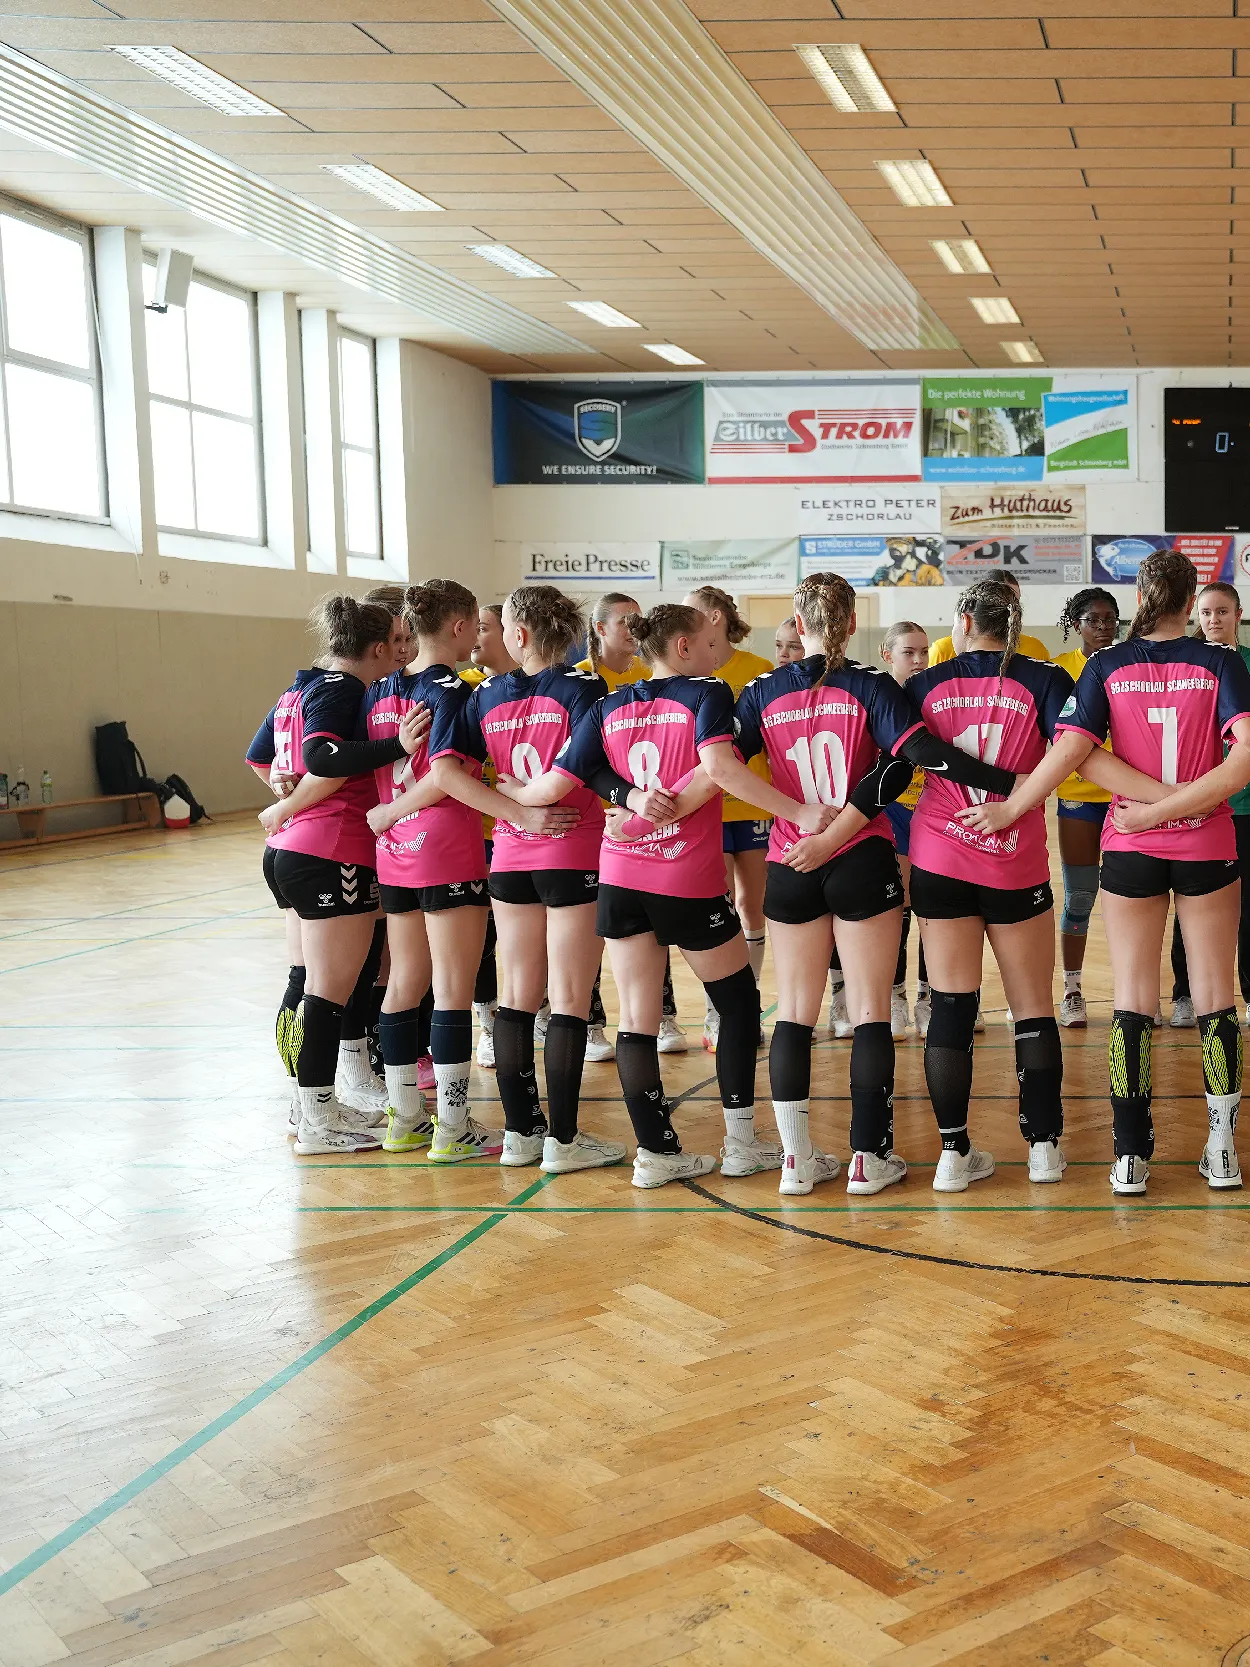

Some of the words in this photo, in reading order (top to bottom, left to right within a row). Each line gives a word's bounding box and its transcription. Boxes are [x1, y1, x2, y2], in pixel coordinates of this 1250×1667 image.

[928, 389, 943, 399] Die
[944, 389, 981, 401] perfekte
[983, 389, 1026, 401] Wohnung
[718, 421, 788, 442] Silber
[542, 465, 559, 475] WE
[561, 465, 602, 475] ENSURE
[603, 465, 656, 475] SECURITY!
[801, 499, 876, 509] ELEKTRO
[884, 498, 937, 508] PETER
[989, 492, 1072, 514] Huthaus
[827, 513, 912, 521] ZSCHORLAU
[531, 553, 582, 573] Freie
[584, 553, 651, 573] Presse
[1110, 682, 1120, 694] SG
[1121, 680, 1165, 693] ZSCHORLAU
[1167, 677, 1215, 692] SCHNEEBERG
[763, 717, 773, 728] SG
[814, 702, 858, 717] SCHNEEBERG
[931, 701, 943, 714] SG
[1148, 707, 1178, 785] 7
[785, 730, 848, 809] 10
